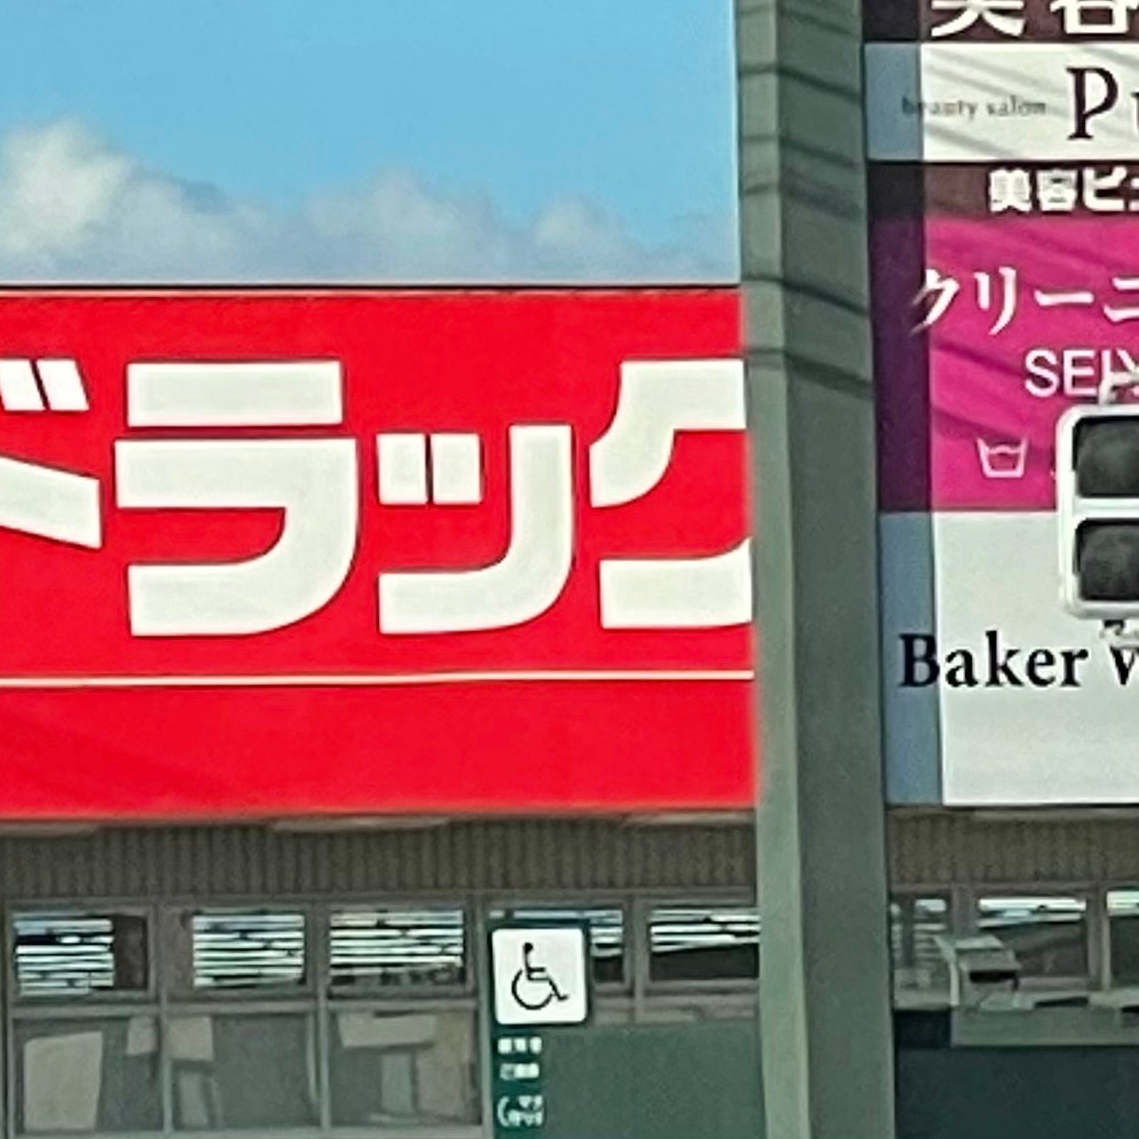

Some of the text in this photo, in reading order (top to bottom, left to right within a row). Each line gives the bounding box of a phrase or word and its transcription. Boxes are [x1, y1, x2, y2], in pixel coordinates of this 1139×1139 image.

[1066, 67, 1139, 141] P
[989, 165, 1139, 212] 美容ビ
[898, 630, 1089, 688] Baker
